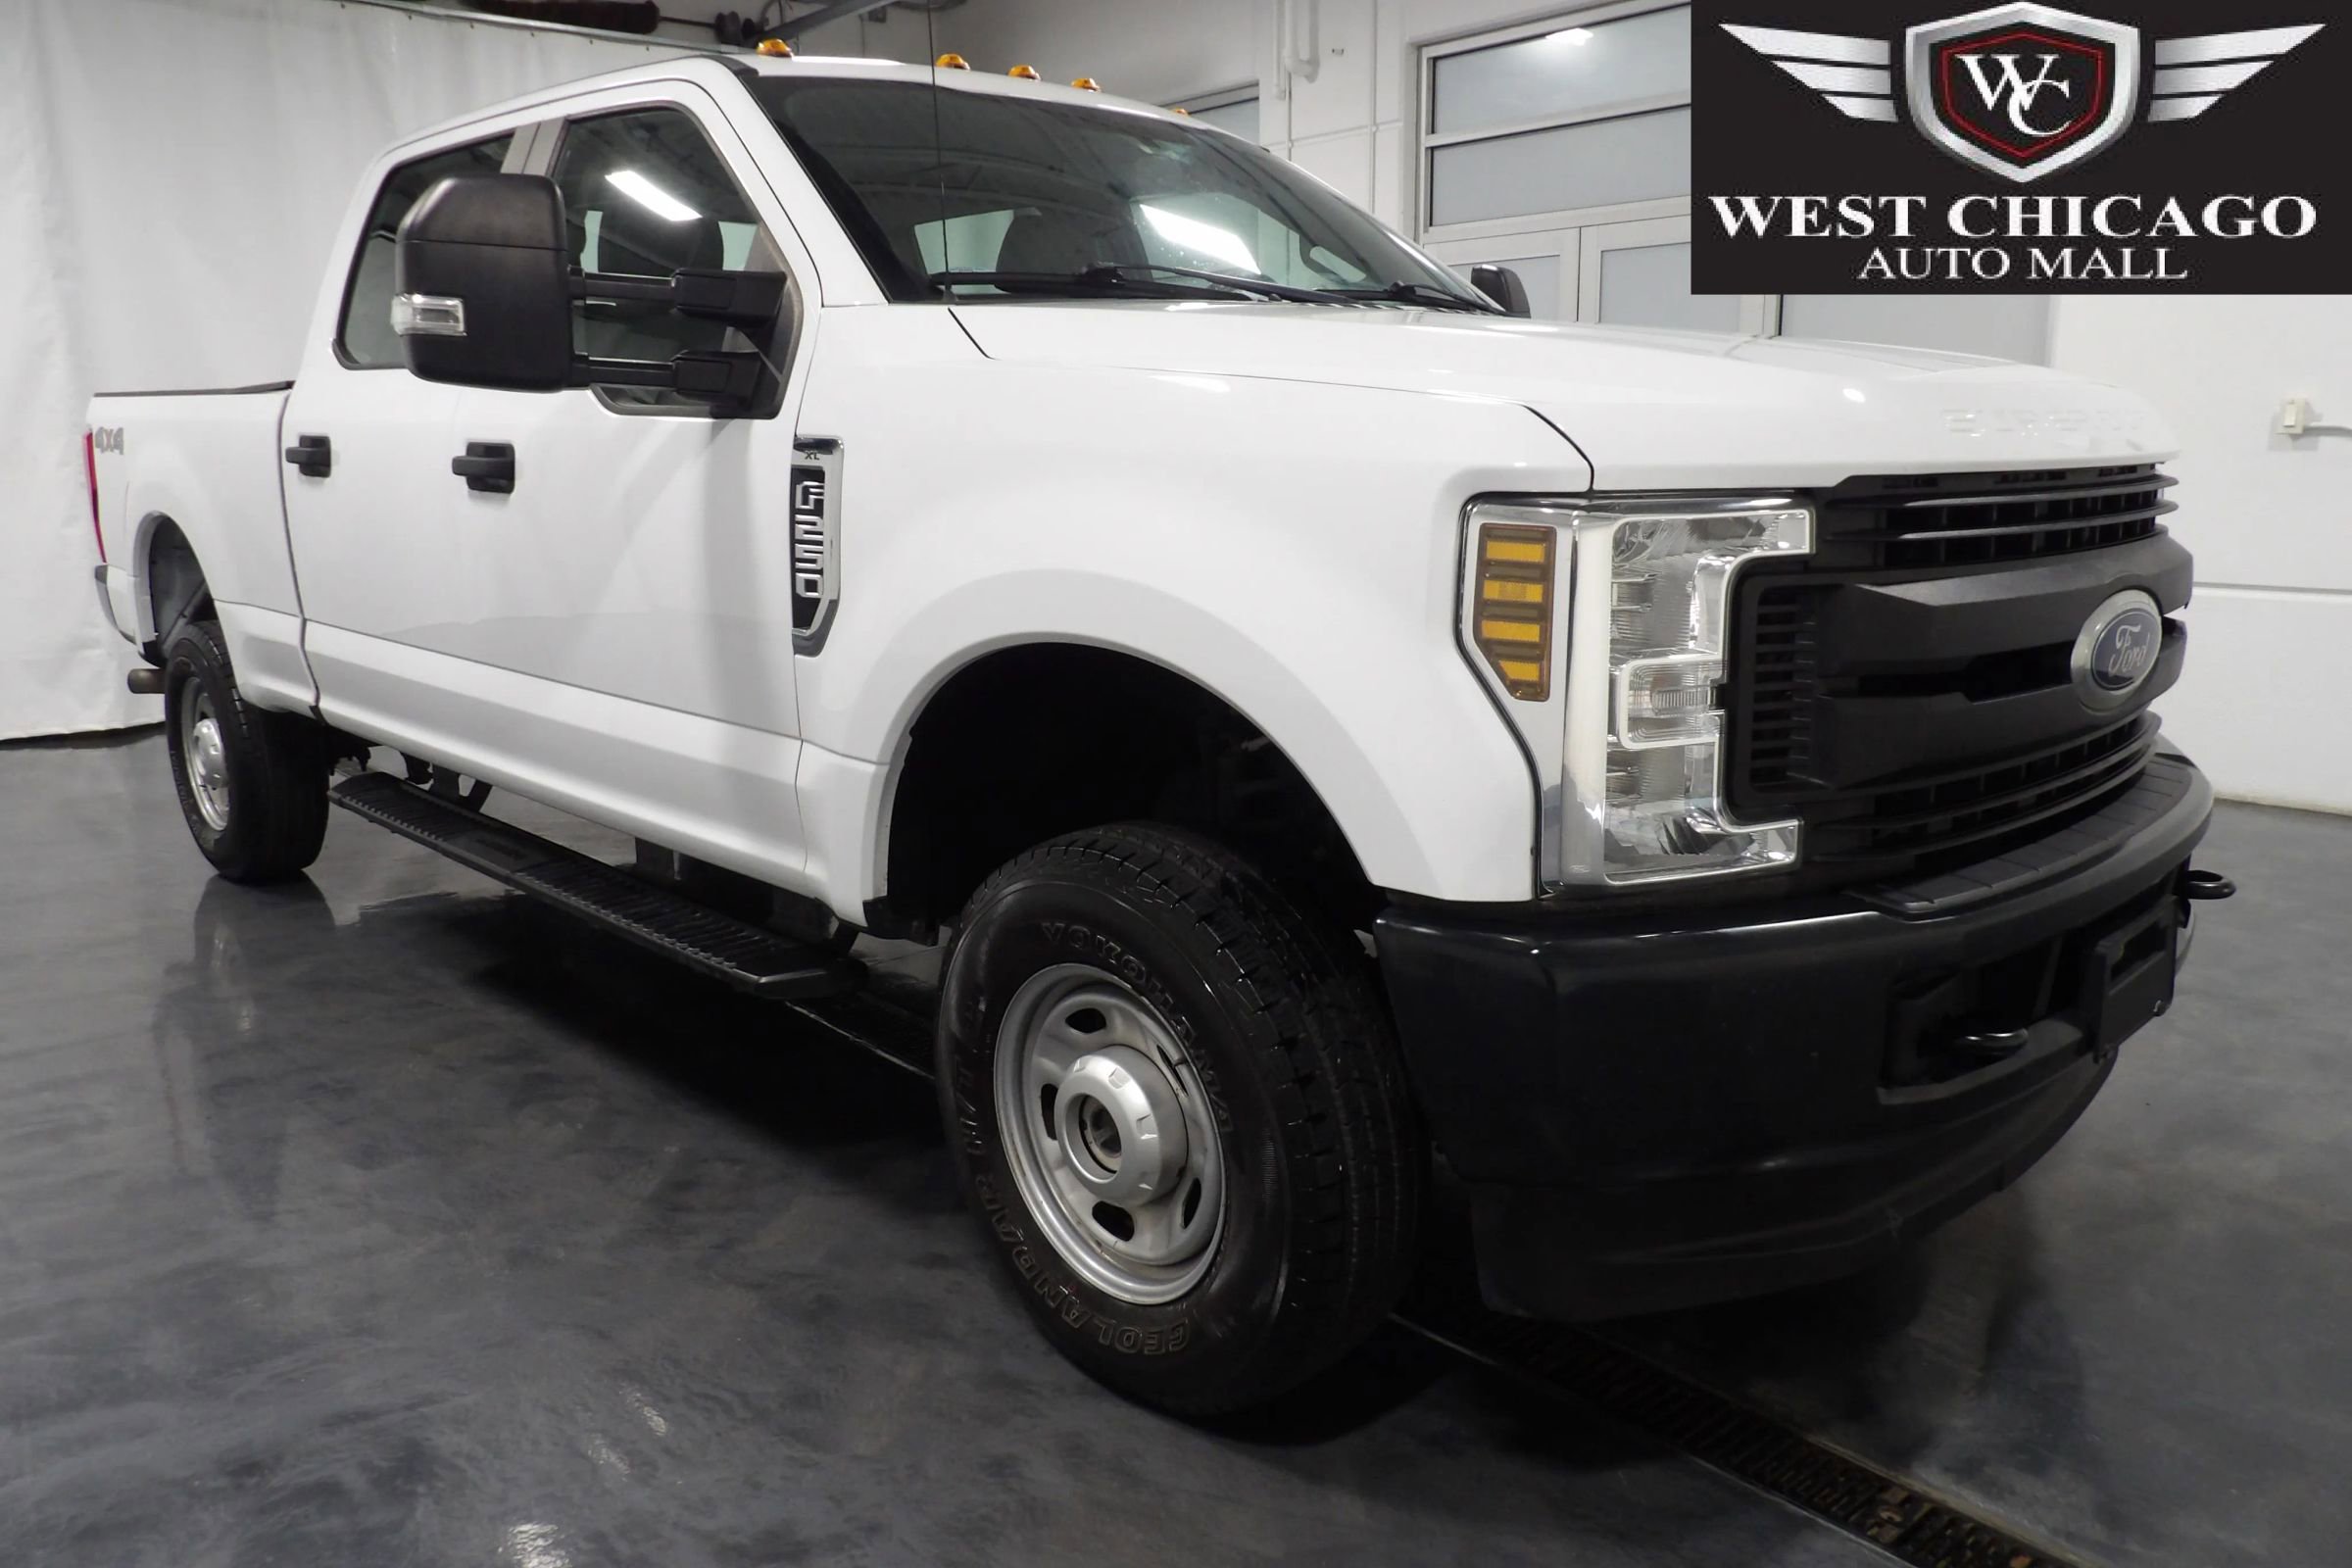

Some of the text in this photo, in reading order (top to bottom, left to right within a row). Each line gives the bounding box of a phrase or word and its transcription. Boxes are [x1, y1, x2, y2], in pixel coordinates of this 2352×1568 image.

[804, 451, 820, 461] XL
[795, 480, 825, 598] F250
[2108, 624, 2151, 674] Ford
[1041, 921, 1234, 1131] YOKOHAMA
[975, 1174, 1192, 1355] GEOLANDAR
